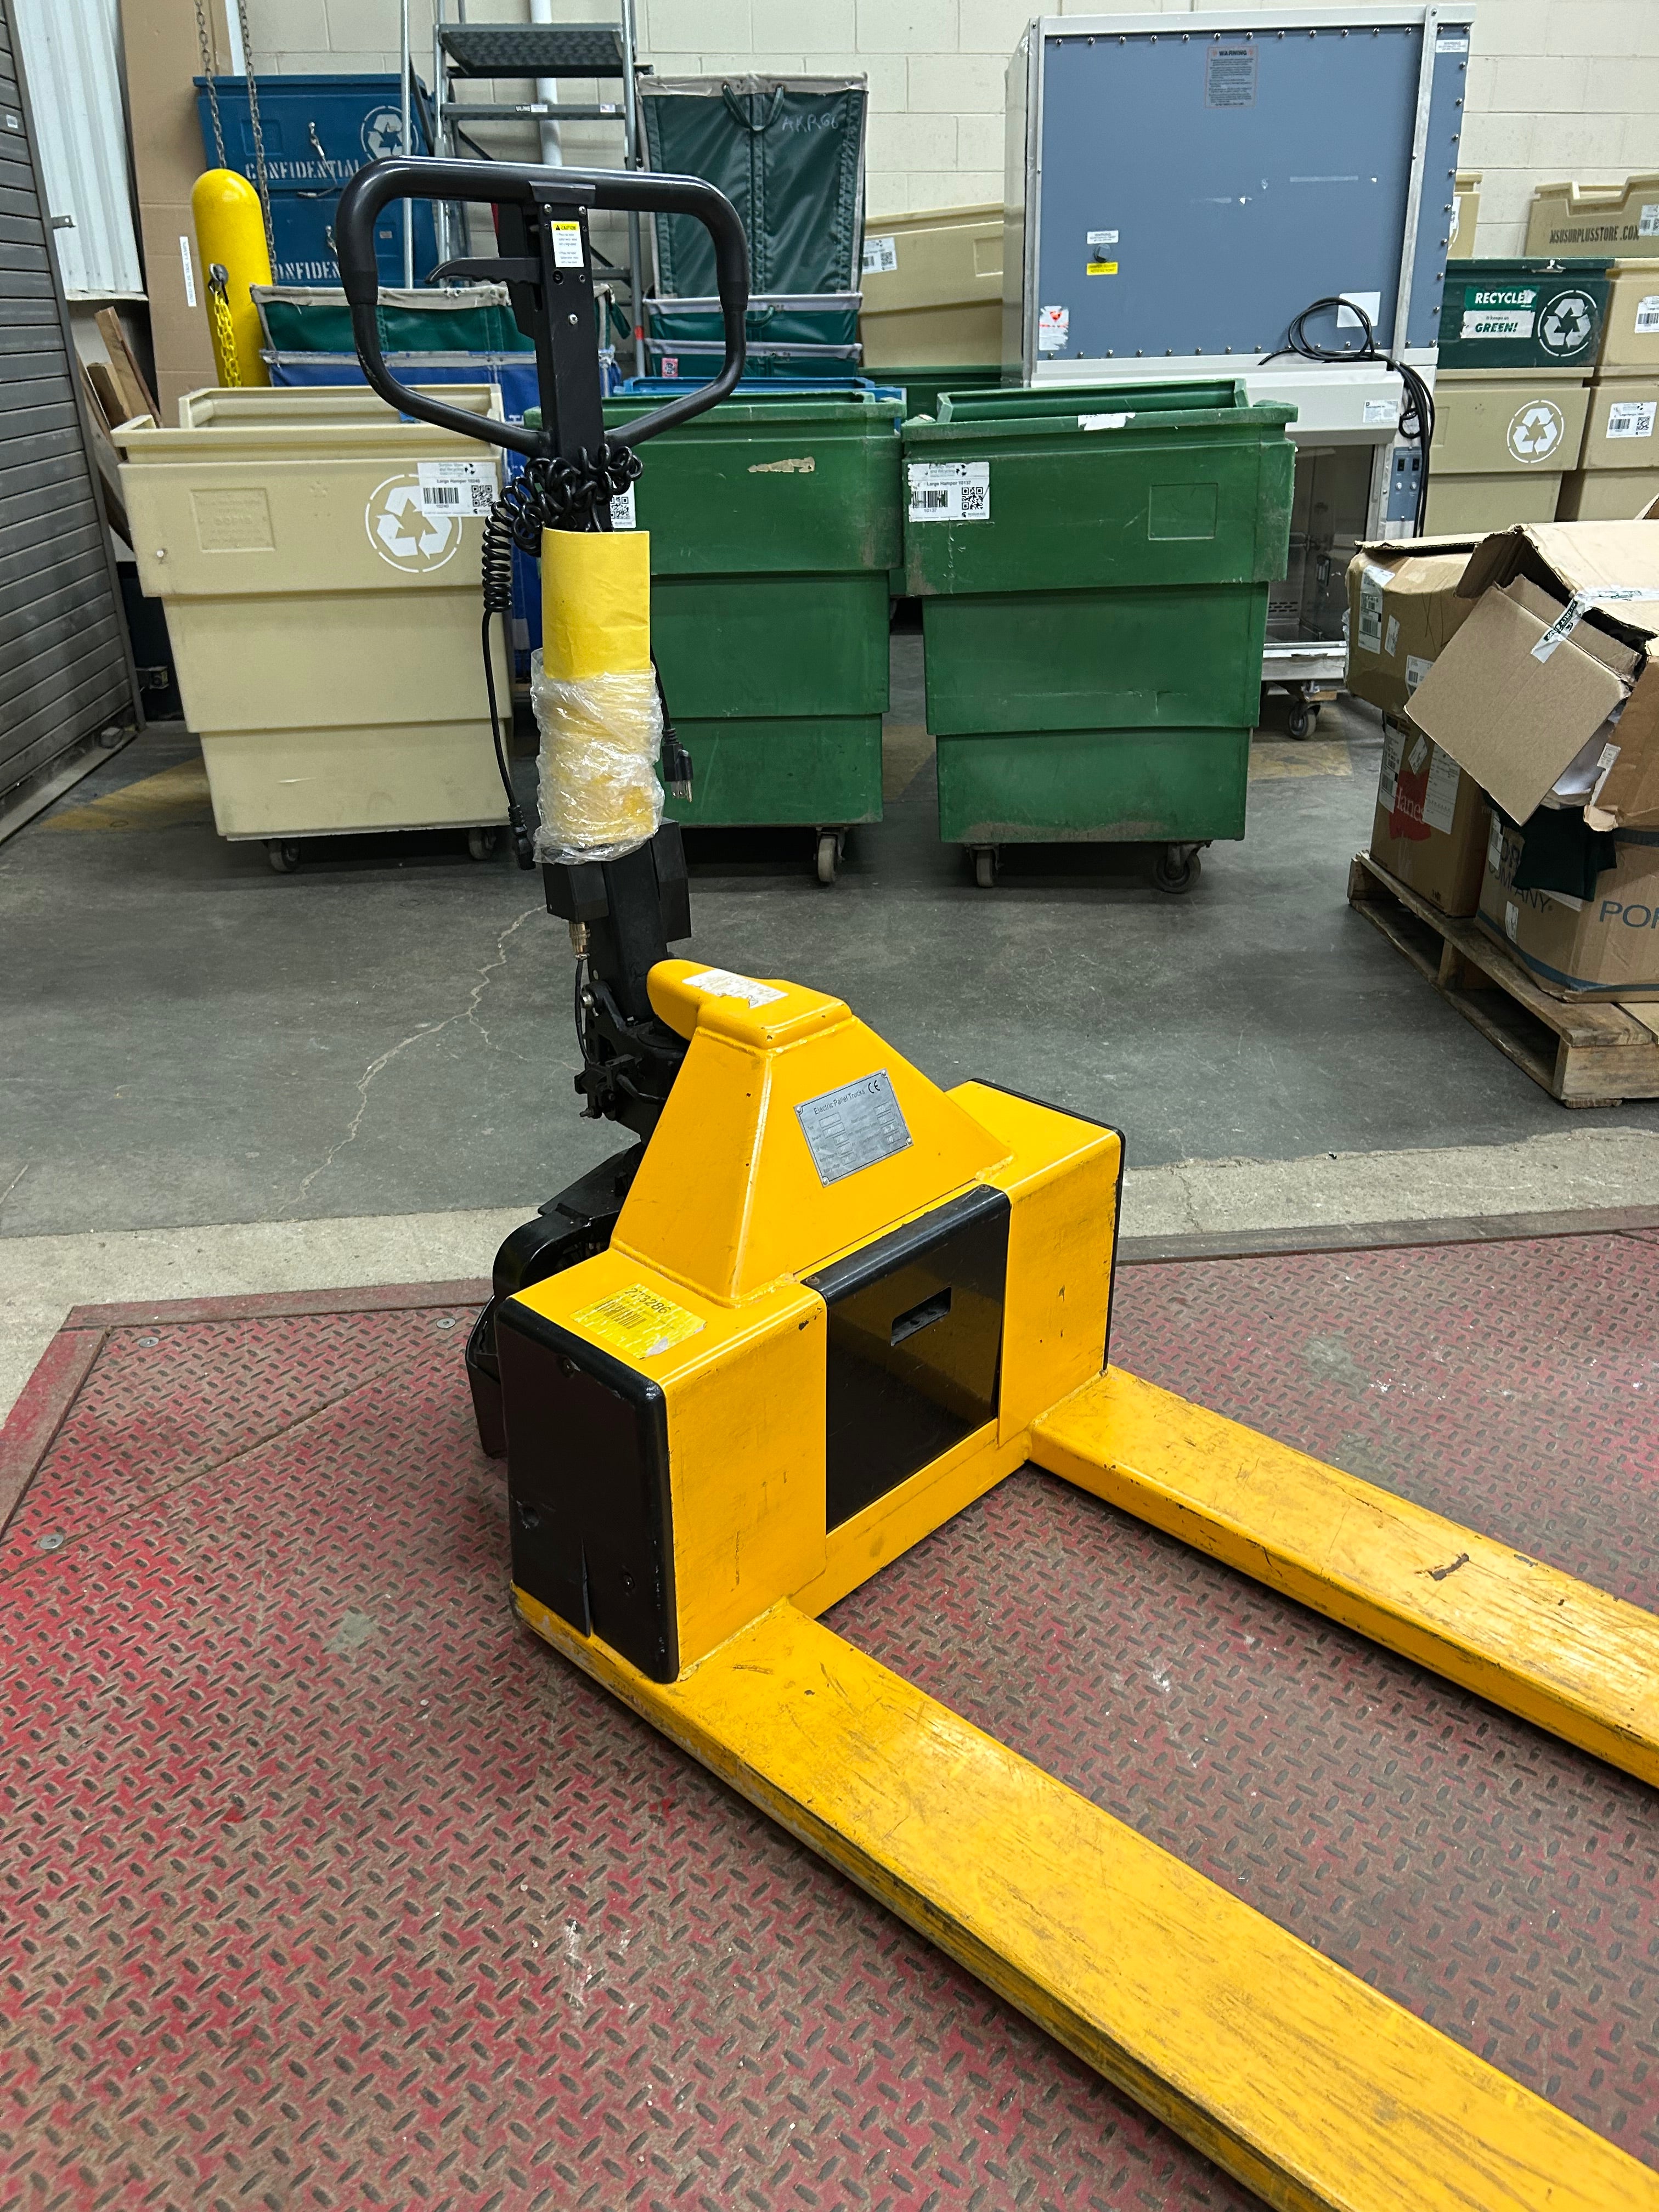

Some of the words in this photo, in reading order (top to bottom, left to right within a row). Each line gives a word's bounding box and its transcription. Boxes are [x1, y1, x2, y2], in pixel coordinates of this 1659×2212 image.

[1475, 322, 1518, 332] GREEN!
[813, 1102, 834, 1115] Electric
[848, 1088, 865, 1101] Trucks
